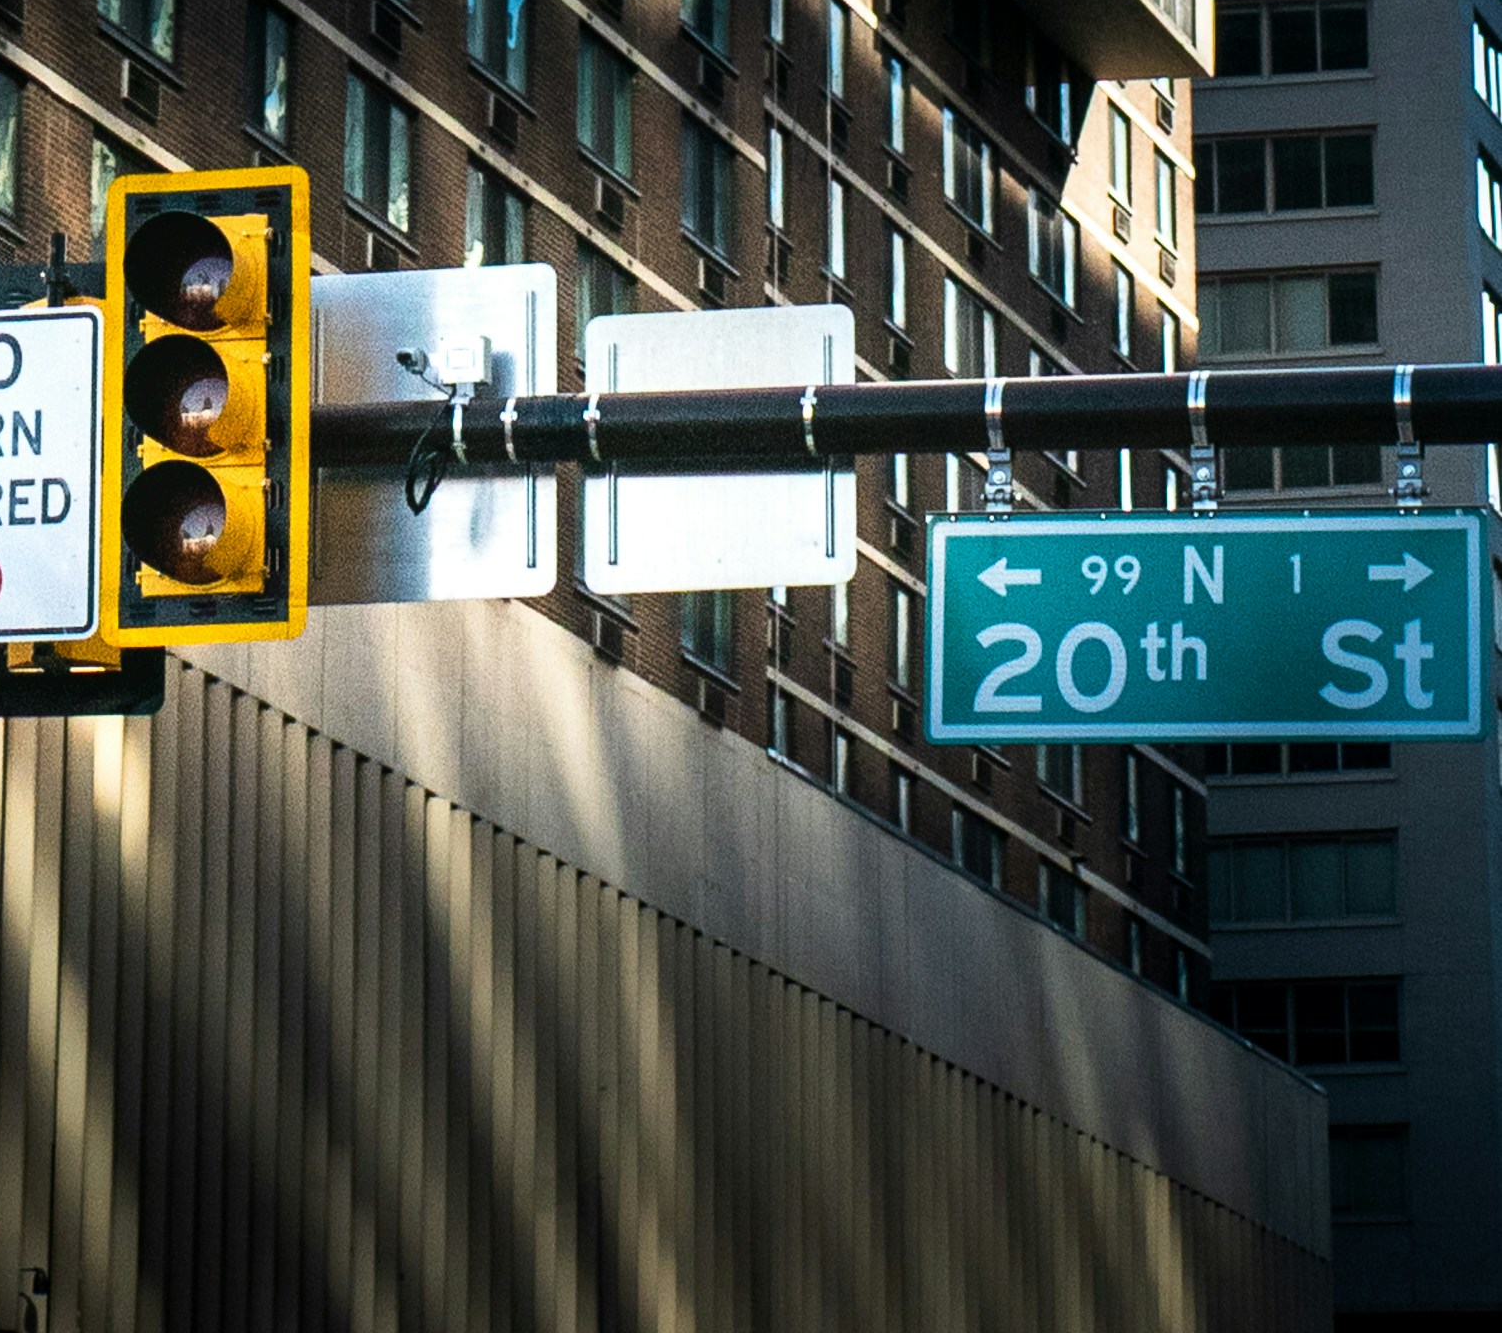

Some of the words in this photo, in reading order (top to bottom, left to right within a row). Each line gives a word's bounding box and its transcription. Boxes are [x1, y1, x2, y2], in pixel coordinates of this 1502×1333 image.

[1081, 554, 1142, 595] 99
[1183, 544, 1224, 605] N
[1289, 553, 1301, 594] 1
[973, 619, 1208, 714] 20th
[1319, 618, 1435, 710] St
